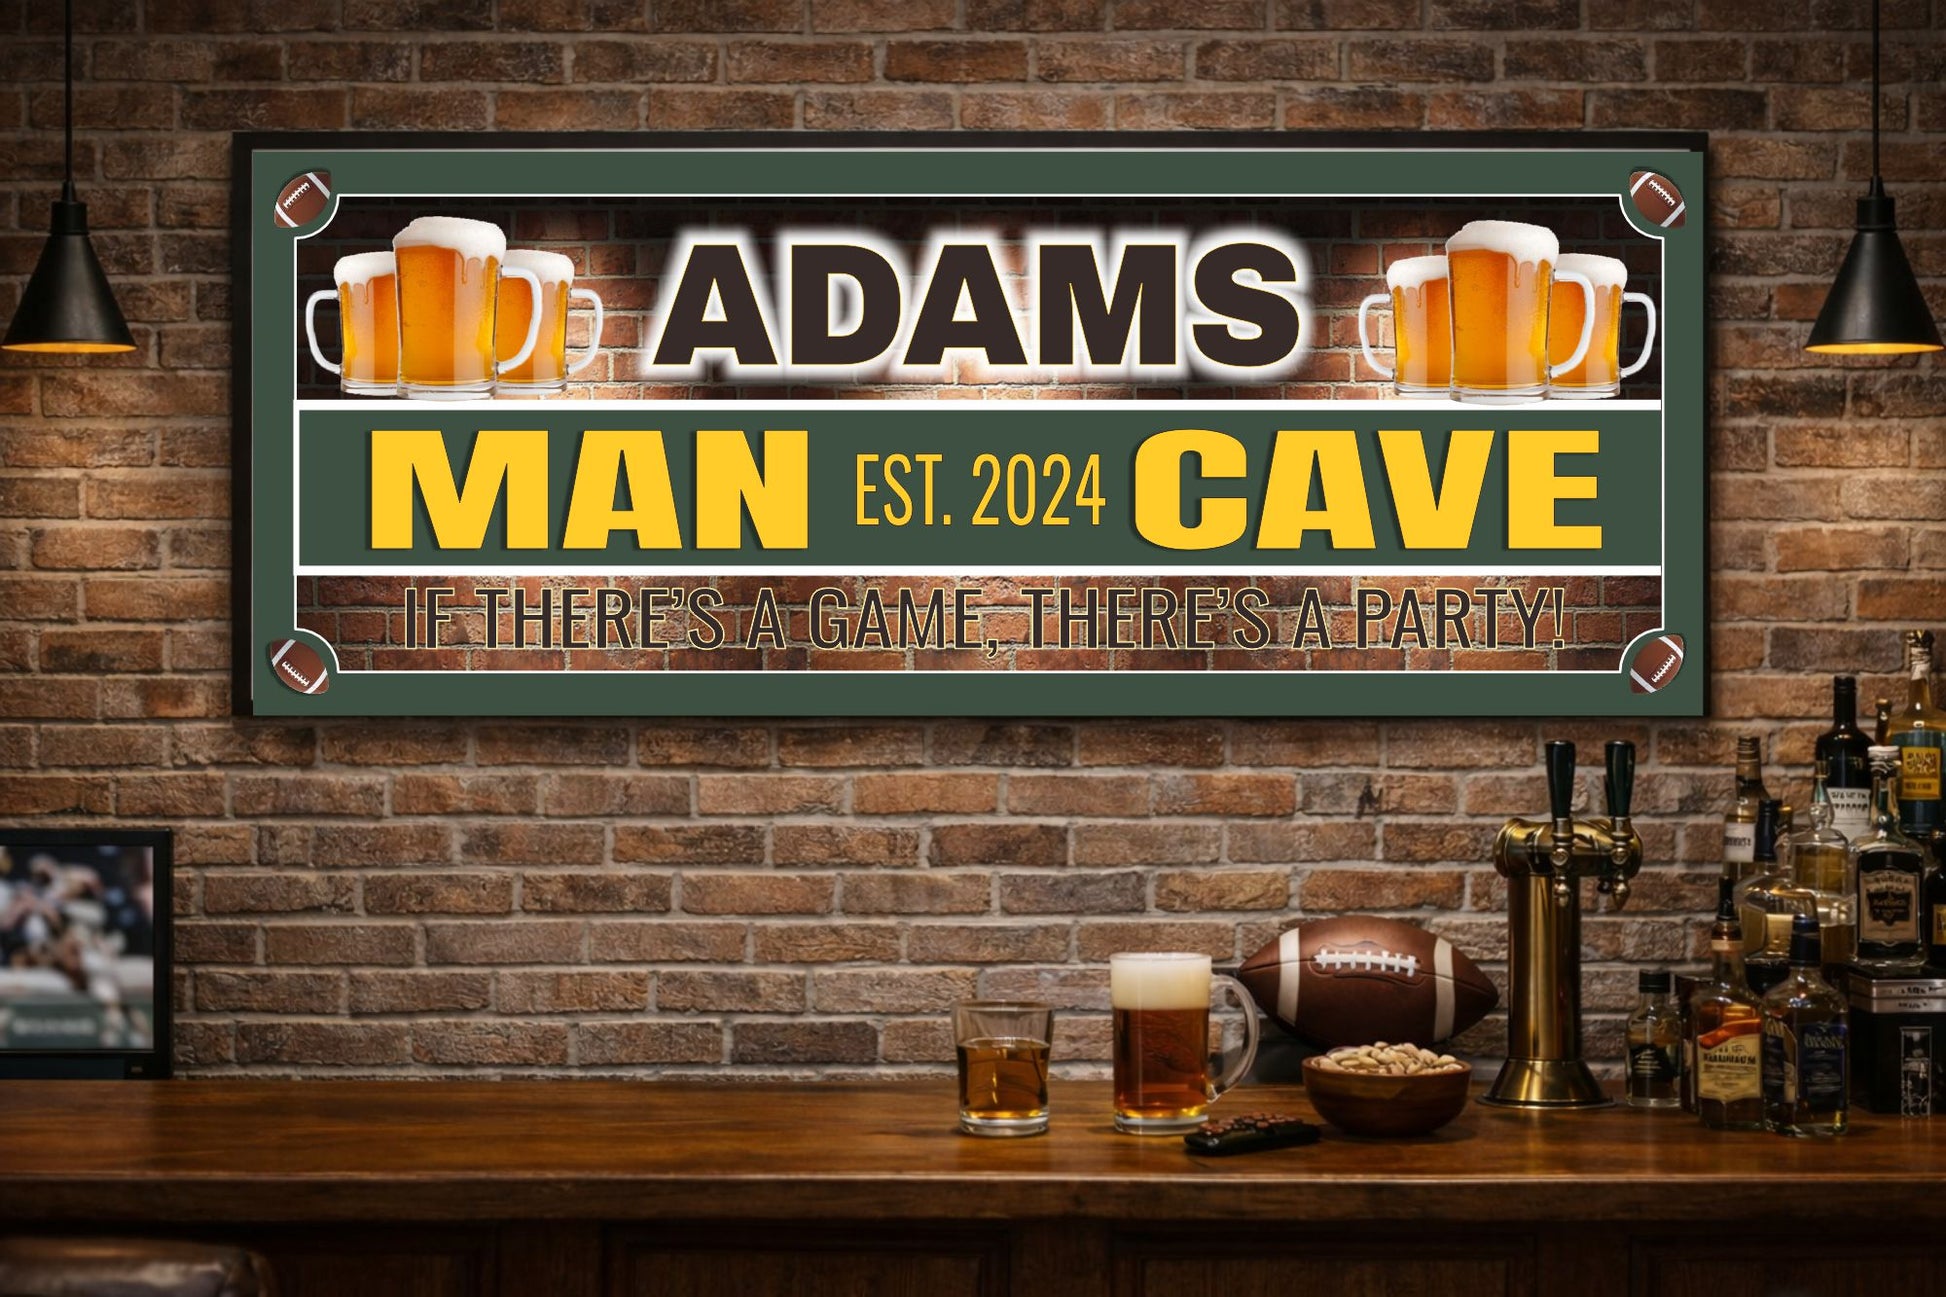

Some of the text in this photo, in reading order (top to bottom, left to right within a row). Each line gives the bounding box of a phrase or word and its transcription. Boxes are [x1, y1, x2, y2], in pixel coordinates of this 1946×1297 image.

[652, 242, 1301, 368] ADAMS
[370, 429, 809, 550] MAN
[855, 453, 1106, 526] EST. 2024
[1134, 428, 1603, 551] CAVE
[404, 586, 1566, 658] IF THERE’S A GAME, THERE’S A PARTY!
